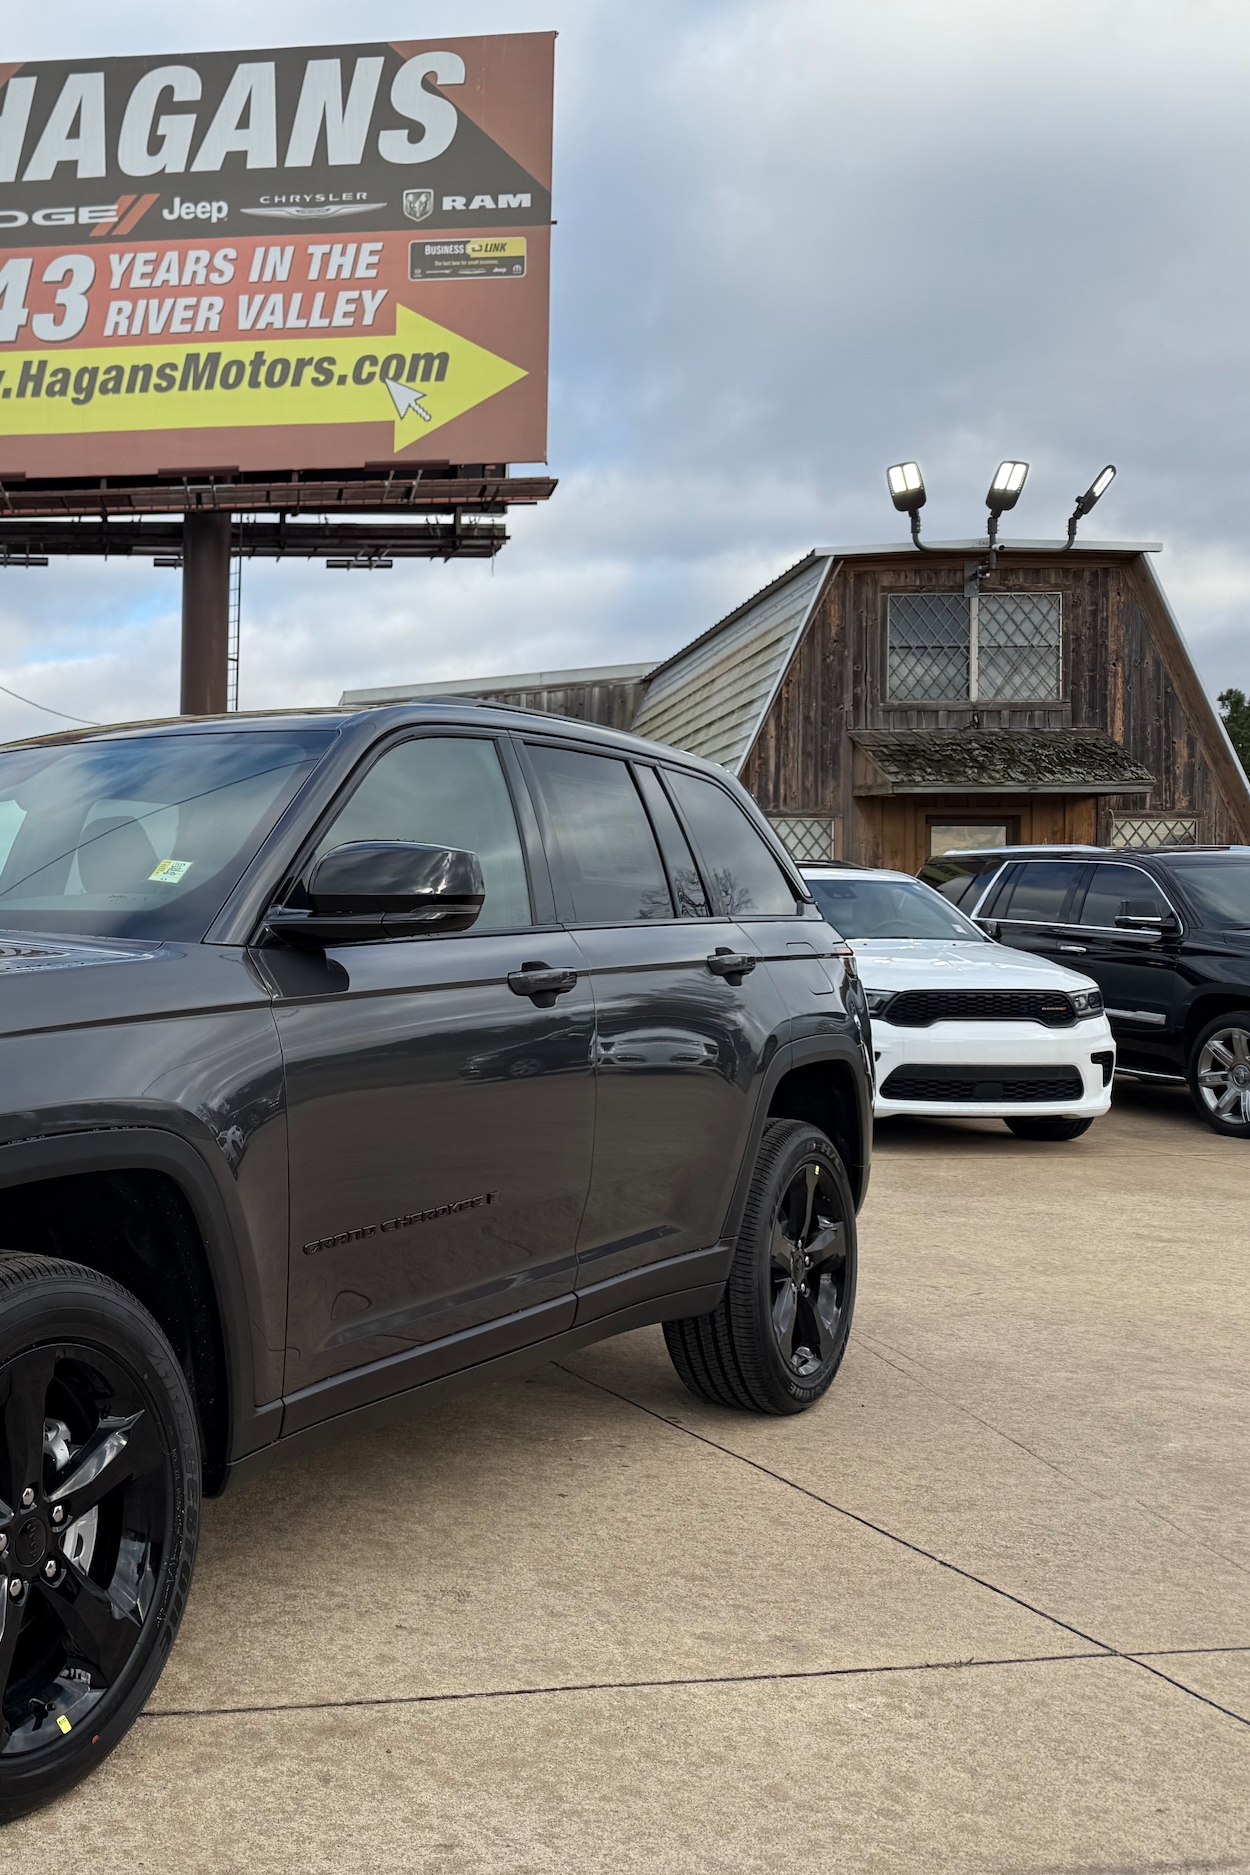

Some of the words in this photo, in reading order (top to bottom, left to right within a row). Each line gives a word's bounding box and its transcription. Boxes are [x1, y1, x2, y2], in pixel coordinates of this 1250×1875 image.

[162, 196, 228, 223] Jeep
[259, 191, 368, 204] CHRYSLER
[442, 193, 532, 211] RAM
[424, 244, 465, 255] BUSINESS
[484, 242, 508, 253] LINK
[108, 247, 238, 290] YEARS
[249, 245, 295, 284] IN
[307, 241, 384, 281] THE
[103, 295, 225, 338] RIVER
[237, 288, 389, 332] VALLEY
[302, 1225, 377, 1256] GRAND
[381, 1195, 485, 1233] CHEROKEE
